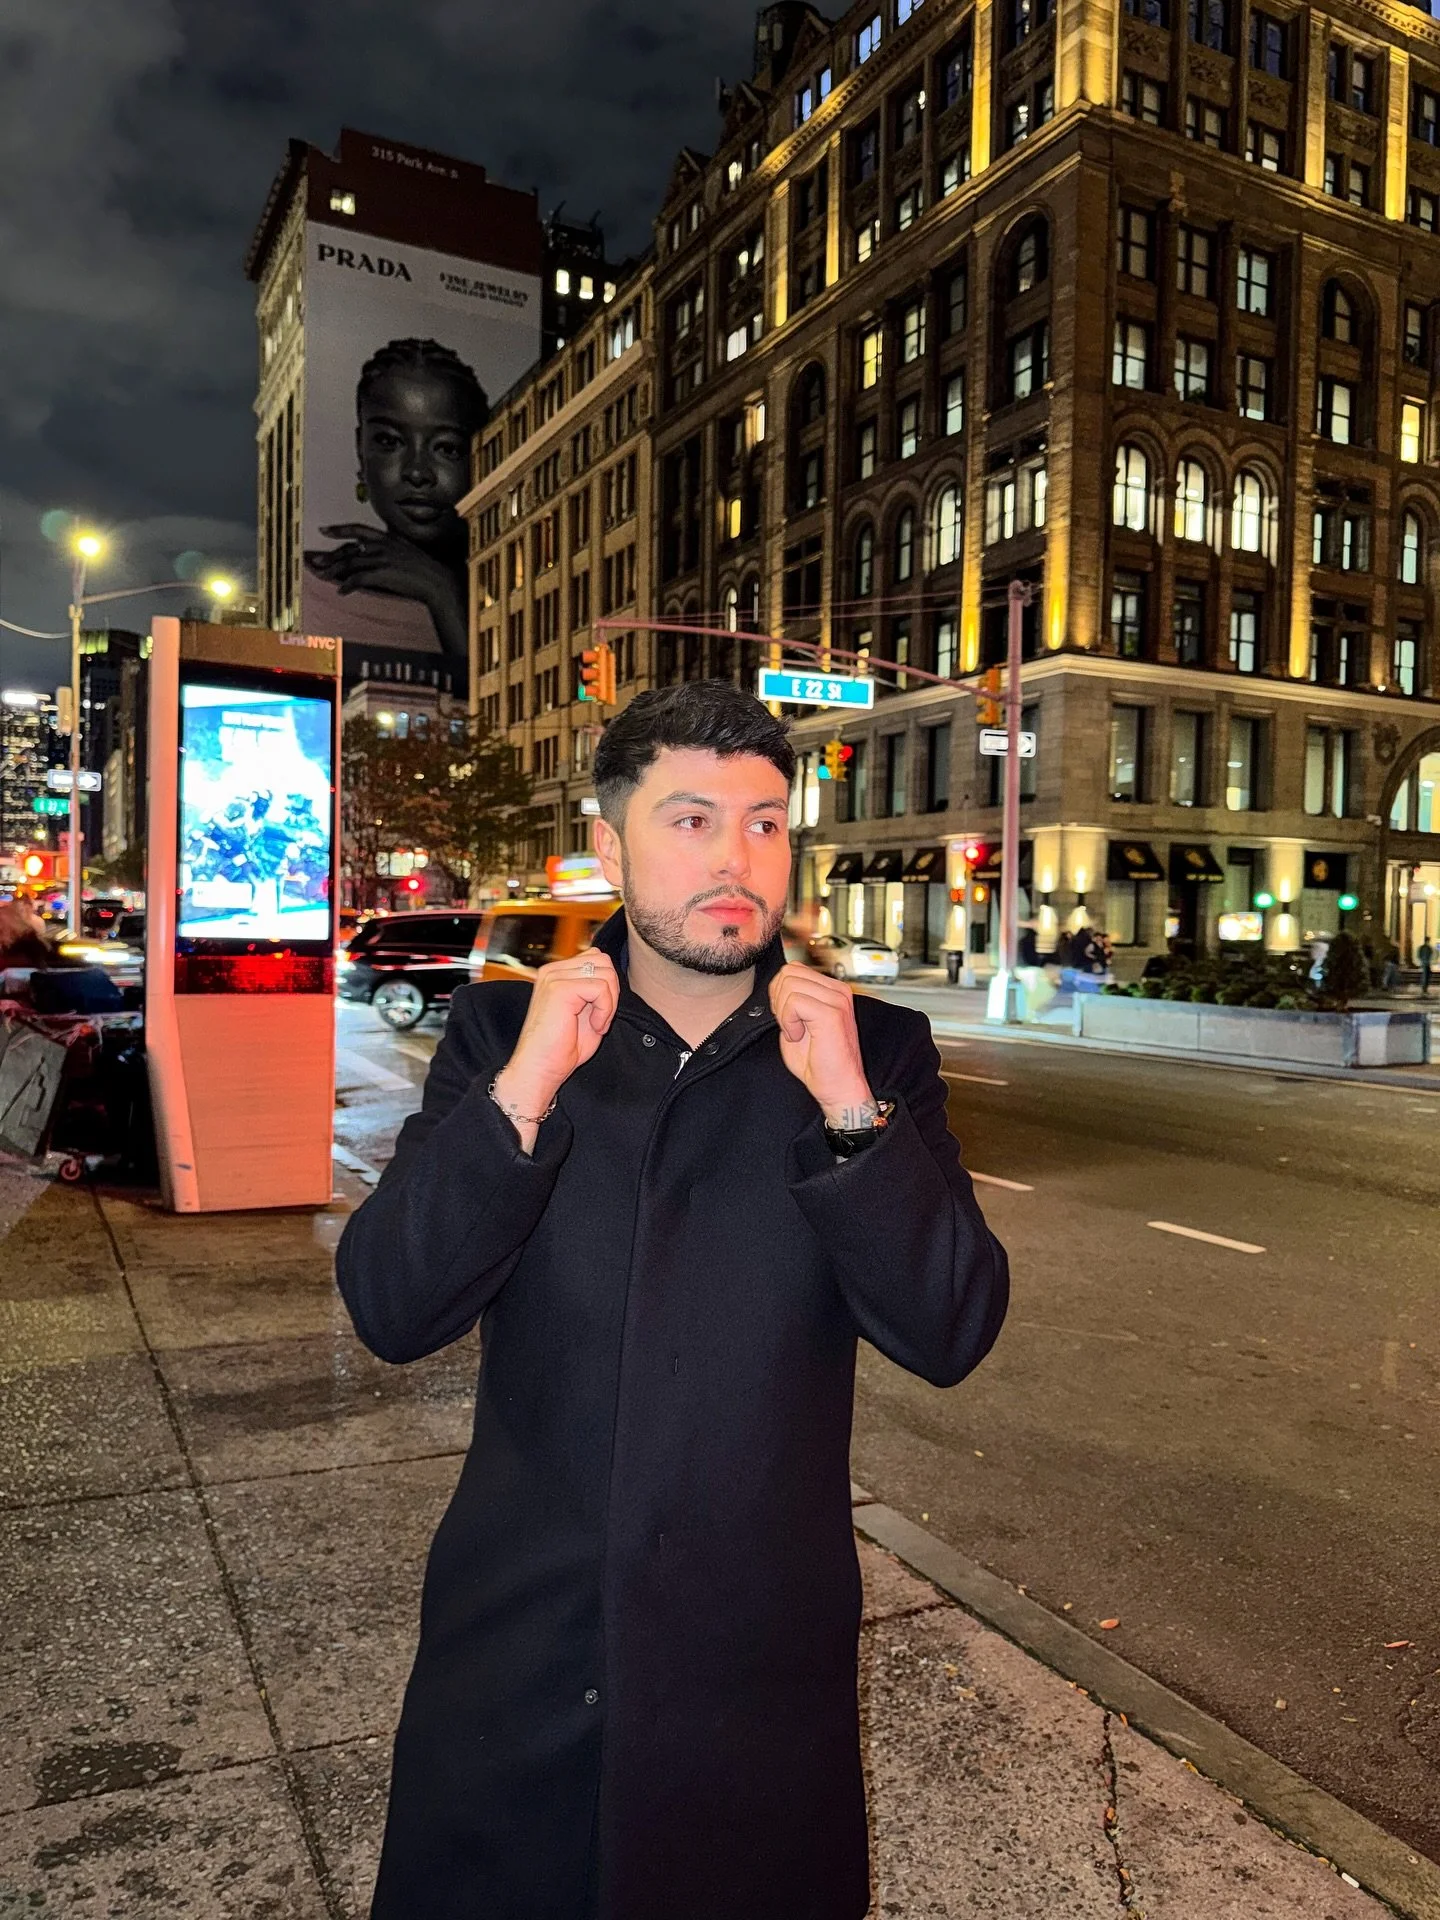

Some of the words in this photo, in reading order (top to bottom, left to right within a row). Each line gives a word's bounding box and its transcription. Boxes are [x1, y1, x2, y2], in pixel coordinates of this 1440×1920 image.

[372, 145, 394, 161] 315
[397, 152, 423, 170] Park
[317, 243, 413, 282] PRADA
[791, 678, 802, 697] E
[805, 679, 824, 699] 22
[827, 681, 842, 700] St
